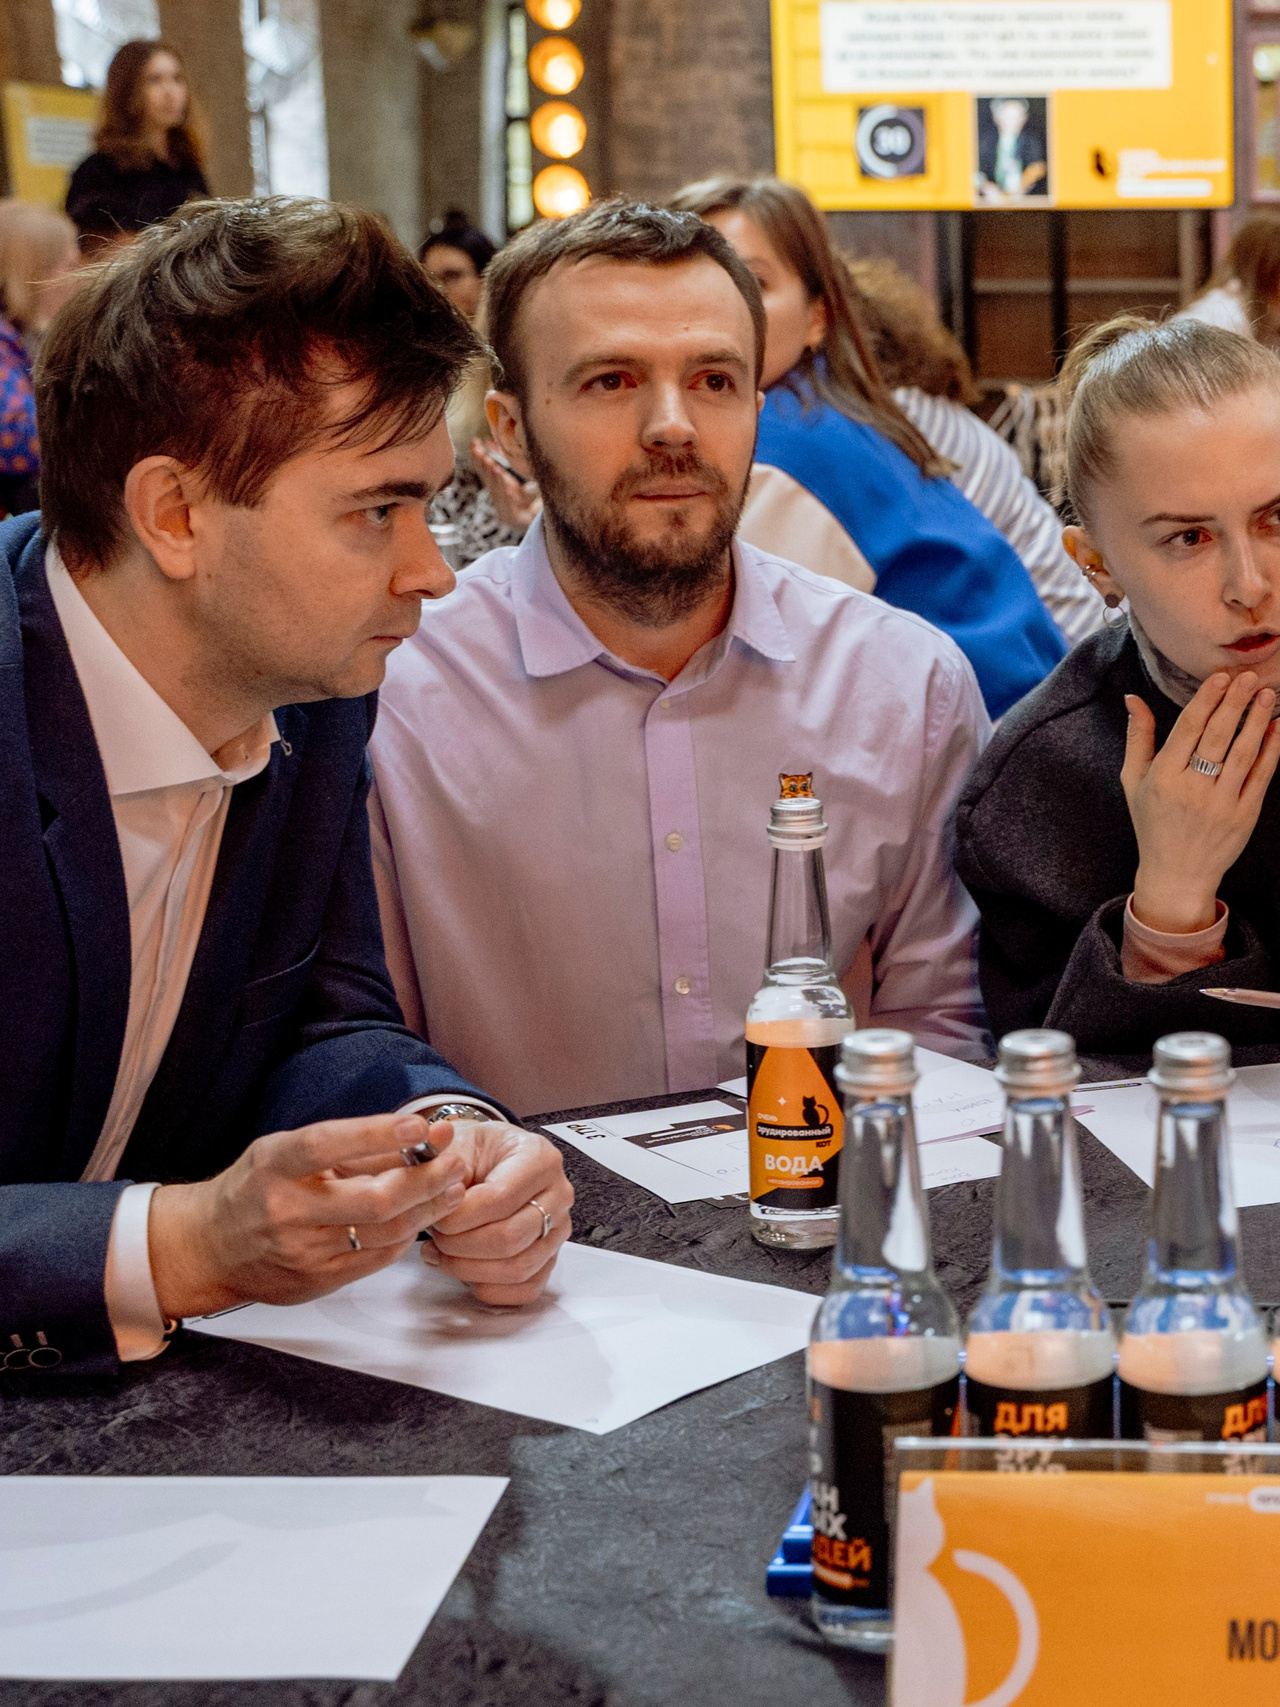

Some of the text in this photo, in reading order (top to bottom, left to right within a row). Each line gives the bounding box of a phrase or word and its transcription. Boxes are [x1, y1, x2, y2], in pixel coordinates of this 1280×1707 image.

[757, 1126, 832, 1138] эрудированный
[765, 1153, 824, 1175] ВОДА
[993, 1402, 1069, 1436] ДЛЯ
[1221, 1392, 1268, 1440] ДЛ
